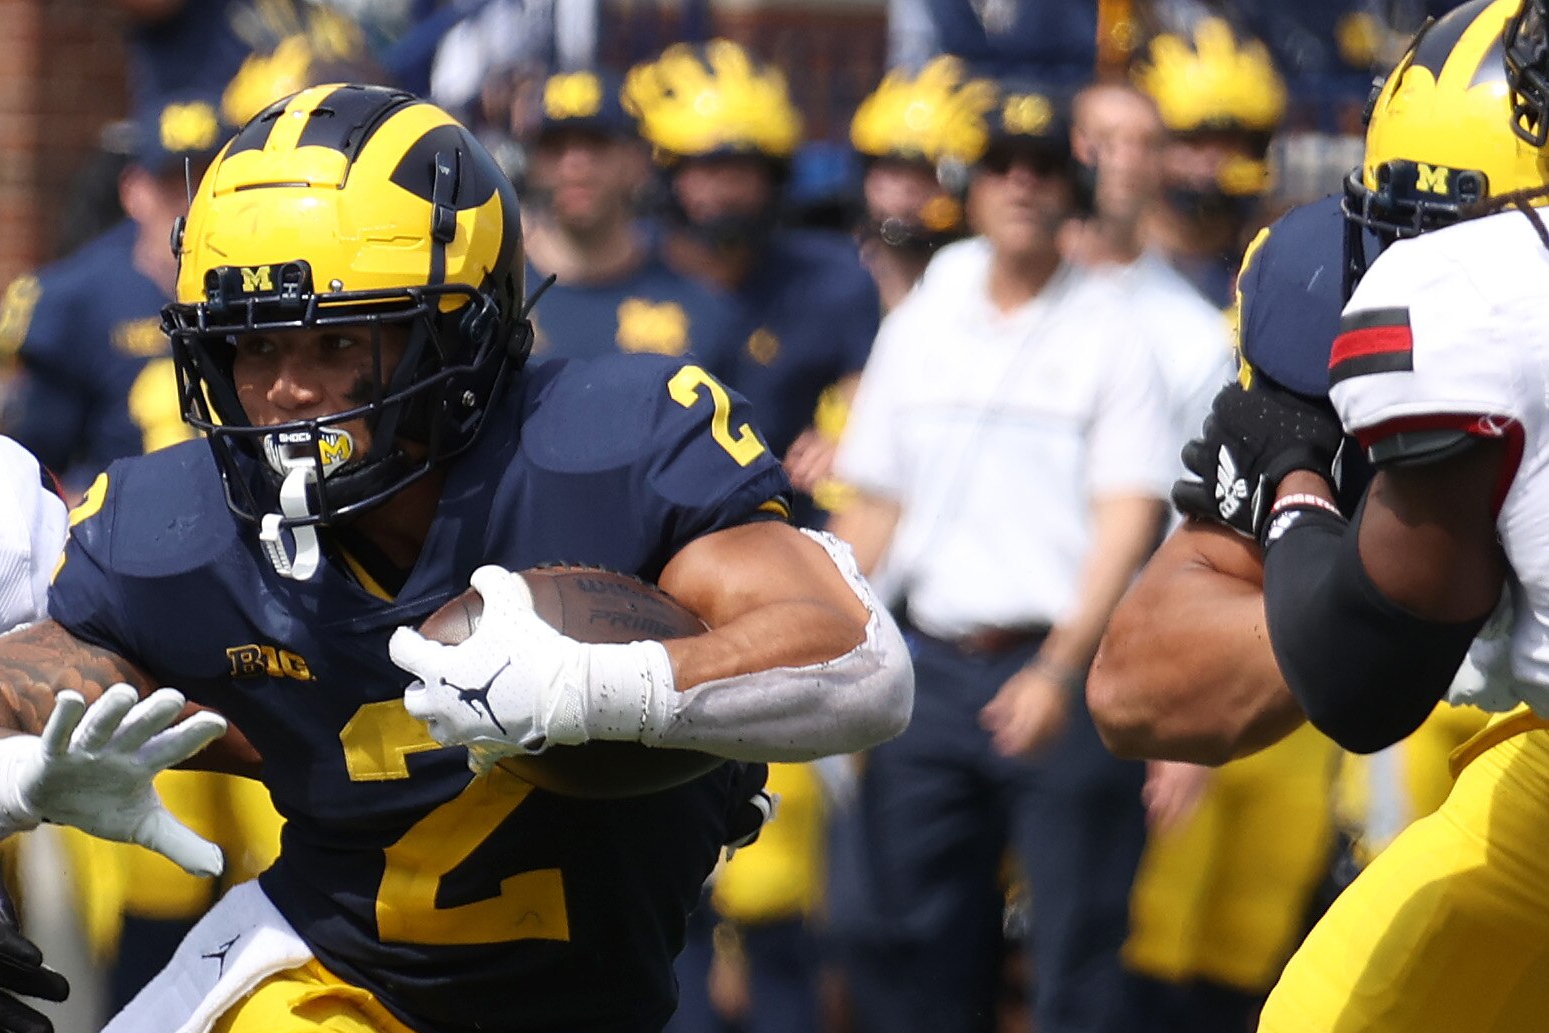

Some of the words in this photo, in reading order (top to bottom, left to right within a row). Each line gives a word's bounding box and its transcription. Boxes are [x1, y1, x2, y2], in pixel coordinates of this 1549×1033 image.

[1416, 162, 1449, 195] M
[240, 265, 273, 292] M
[667, 365, 766, 468] 2
[318, 435, 351, 465] M
[338, 697, 571, 946] 2
